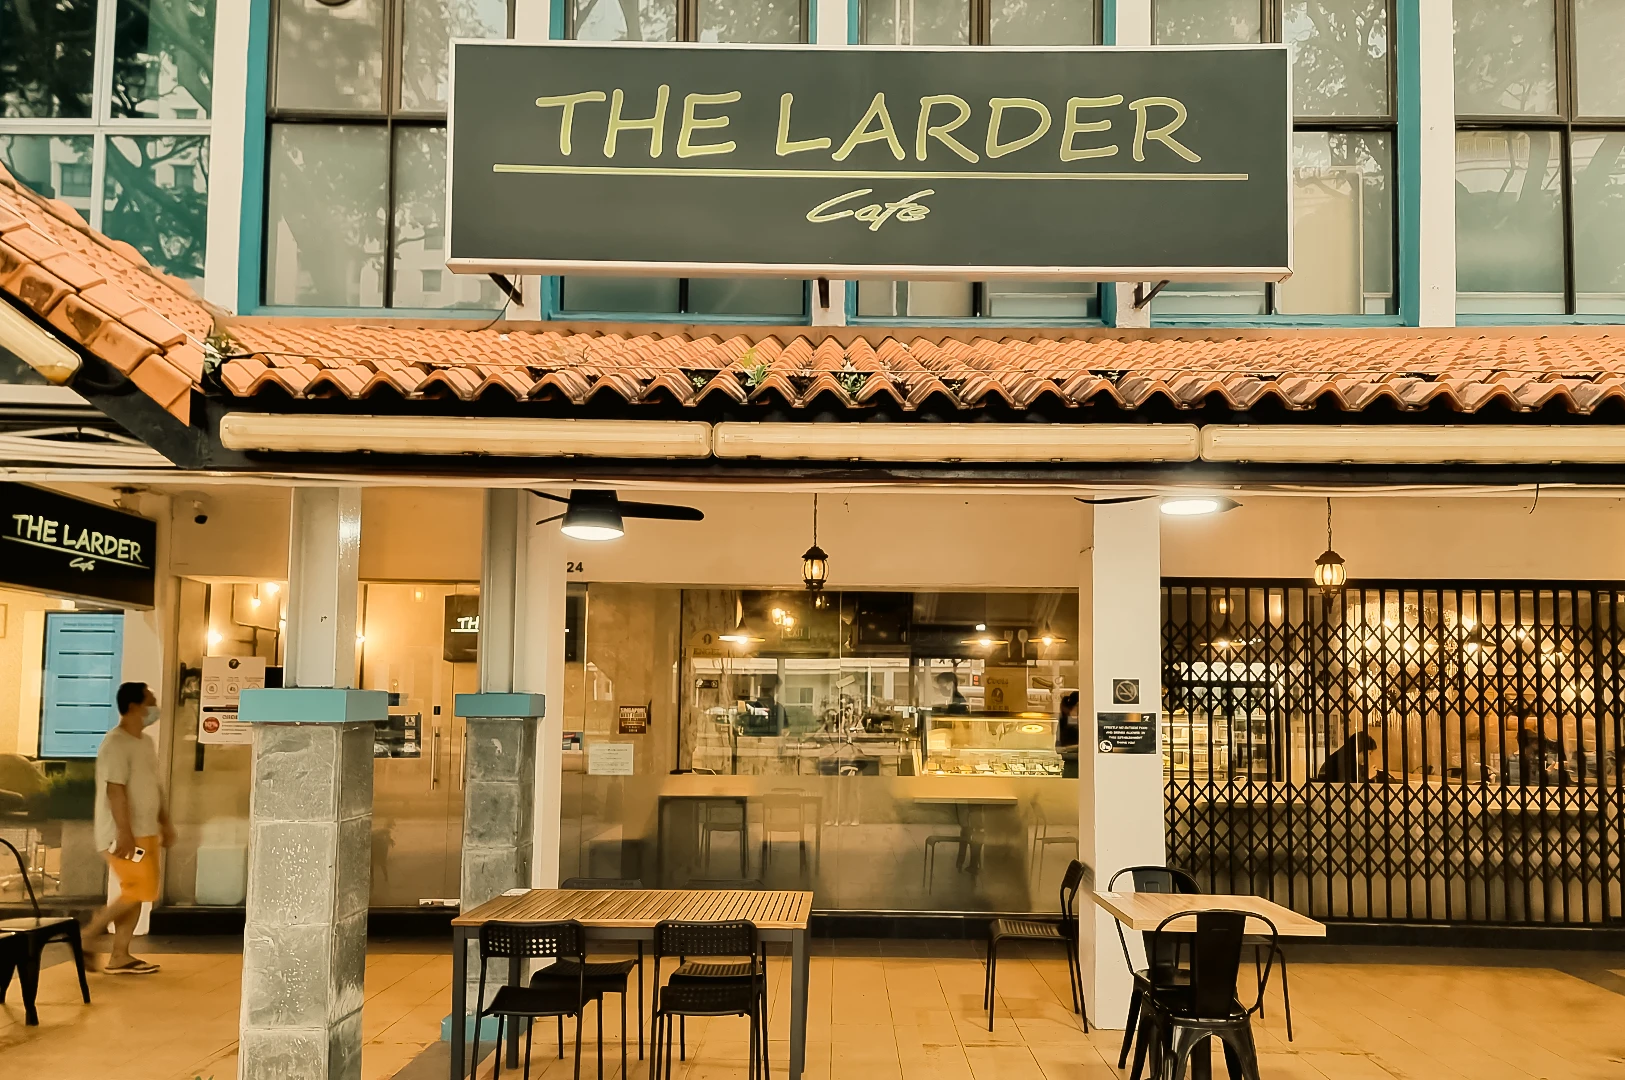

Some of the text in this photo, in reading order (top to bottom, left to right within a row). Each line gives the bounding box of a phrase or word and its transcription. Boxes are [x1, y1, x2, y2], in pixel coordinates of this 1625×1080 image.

[535, 84, 1202, 164] THE LARDER
[12, 514, 143, 563] THE LARDER
[566, 561, 584, 573] 24
[456, 615, 480, 630] TH
